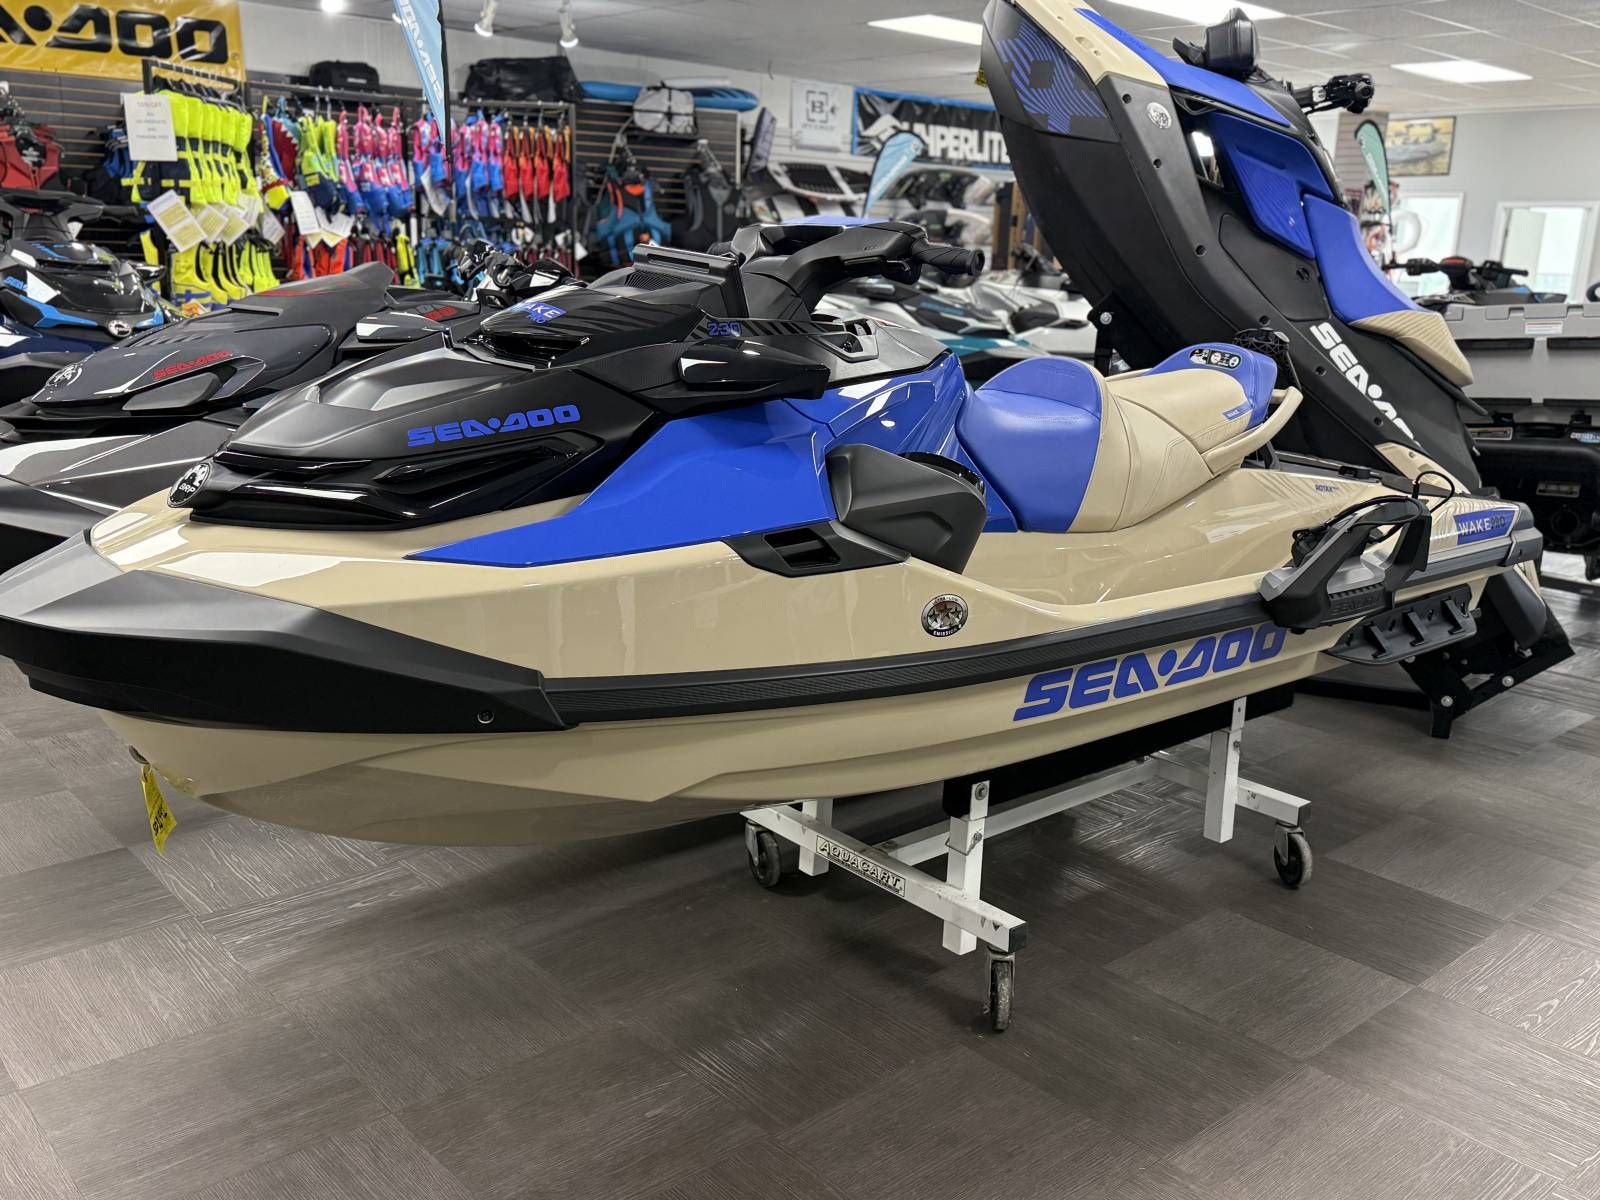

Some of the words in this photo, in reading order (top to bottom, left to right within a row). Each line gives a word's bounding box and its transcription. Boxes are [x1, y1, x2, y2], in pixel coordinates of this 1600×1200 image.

[902, 121, 1011, 164] YPERLITE
[707, 322, 742, 336] 230
[179, 483, 196, 493] BRP
[1459, 517, 1491, 536] WAKE
[820, 840, 902, 888] AQUACART
